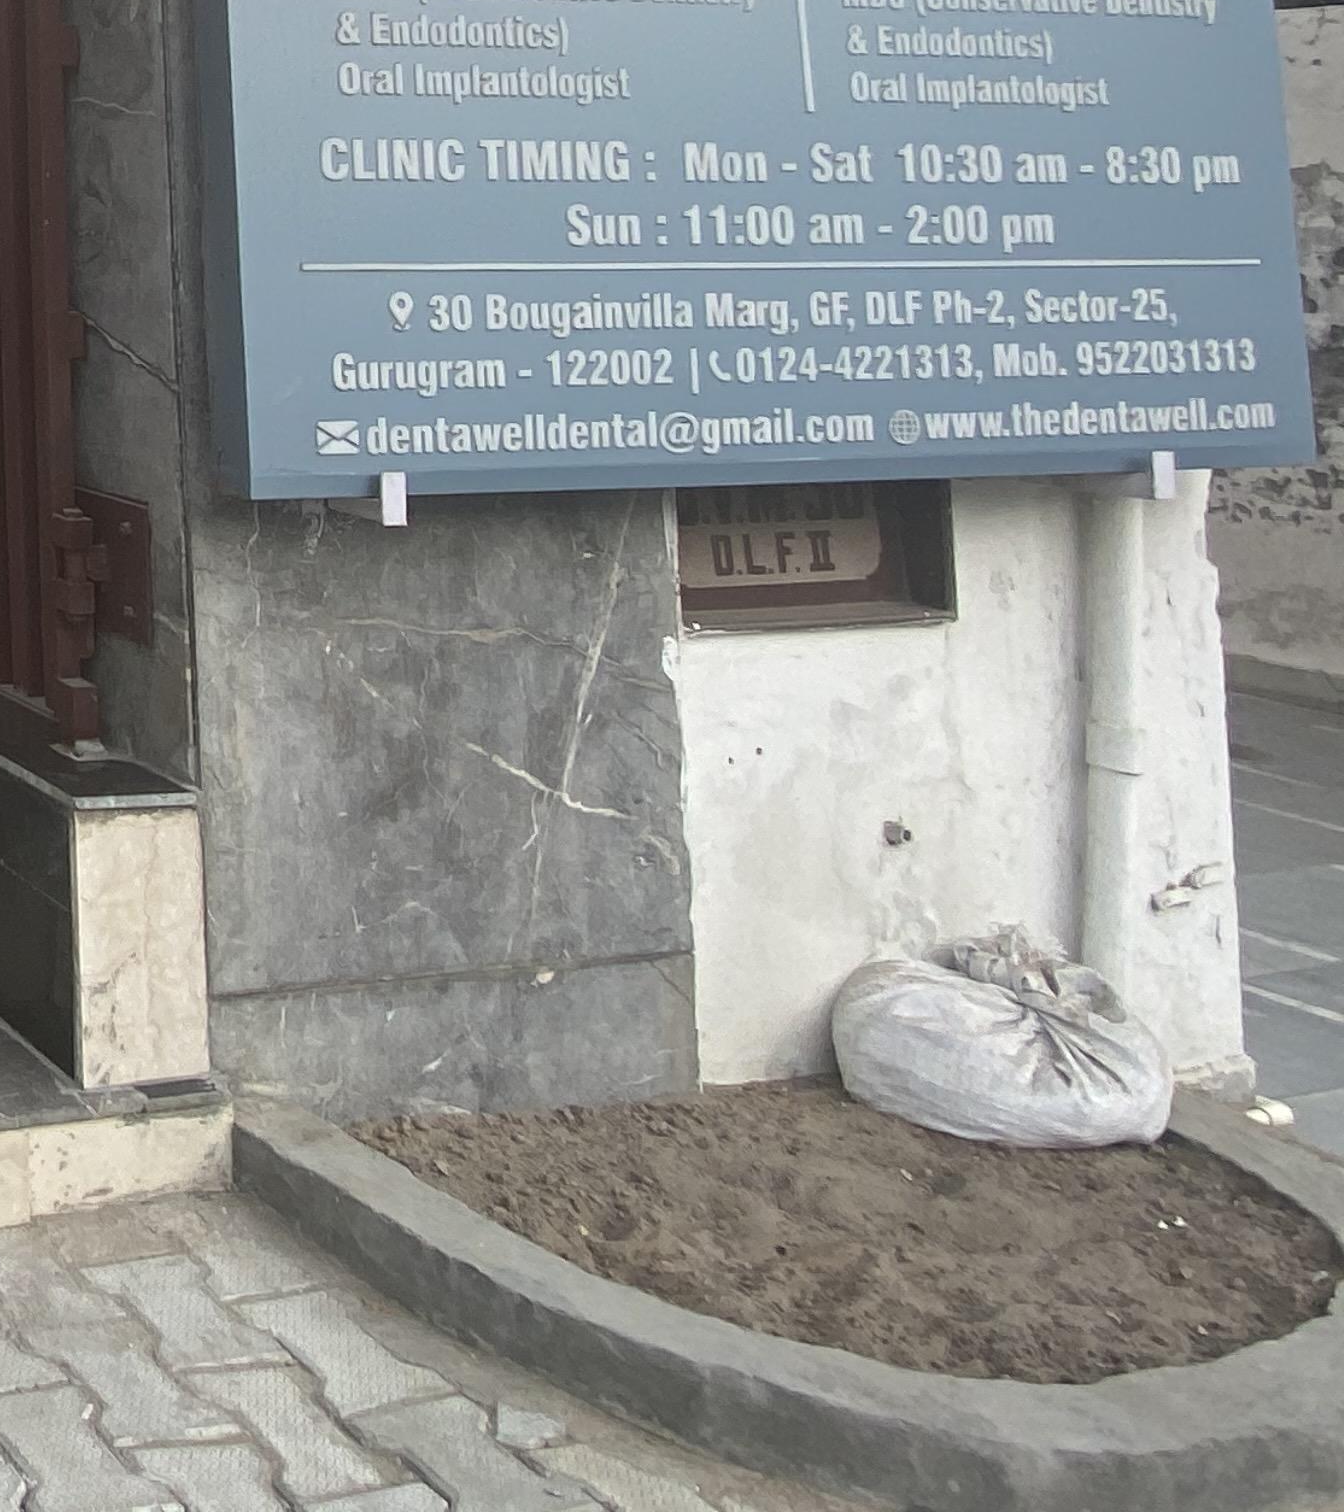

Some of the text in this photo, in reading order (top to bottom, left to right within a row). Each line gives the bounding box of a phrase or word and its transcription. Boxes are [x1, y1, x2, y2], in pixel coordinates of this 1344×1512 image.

[336, 13, 569, 56] & Endodontics)
[847, 26, 1053, 65] & Endodontics)
[339, 63, 631, 105] Oral Implantologist
[850, 71, 1110, 111] Oral Implantologist
[320, 137, 465, 182] CLINIC
[682, 142, 768, 182] Mon
[810, 142, 872, 183] Sat
[895, 143, 1004, 184] 10:30
[1015, 153, 1067, 184] am
[1105, 146, 1182, 185] 8:30
[1192, 153, 1240, 193] pm
[565, 203, 642, 247] Sun
[682, 204, 796, 246] 11:00
[808, 213, 864, 246] am
[905, 204, 989, 245] 2:00
[1000, 212, 1054, 254] pm
[427, 287, 1178, 338] 30 Bougainvilla Marg, GF, DLF Ph-2, Sector-25,
[332, 352, 507, 397] Gurugram
[543, 348, 674, 387] 122002
[736, 342, 984, 385] 0124-4221313,
[992, 341, 1067, 379] Mob.
[1077, 336, 1257, 377] 9522031313
[366, 395, 1275, 456] dentawelldental@gmail.com www.thedentawell.com
